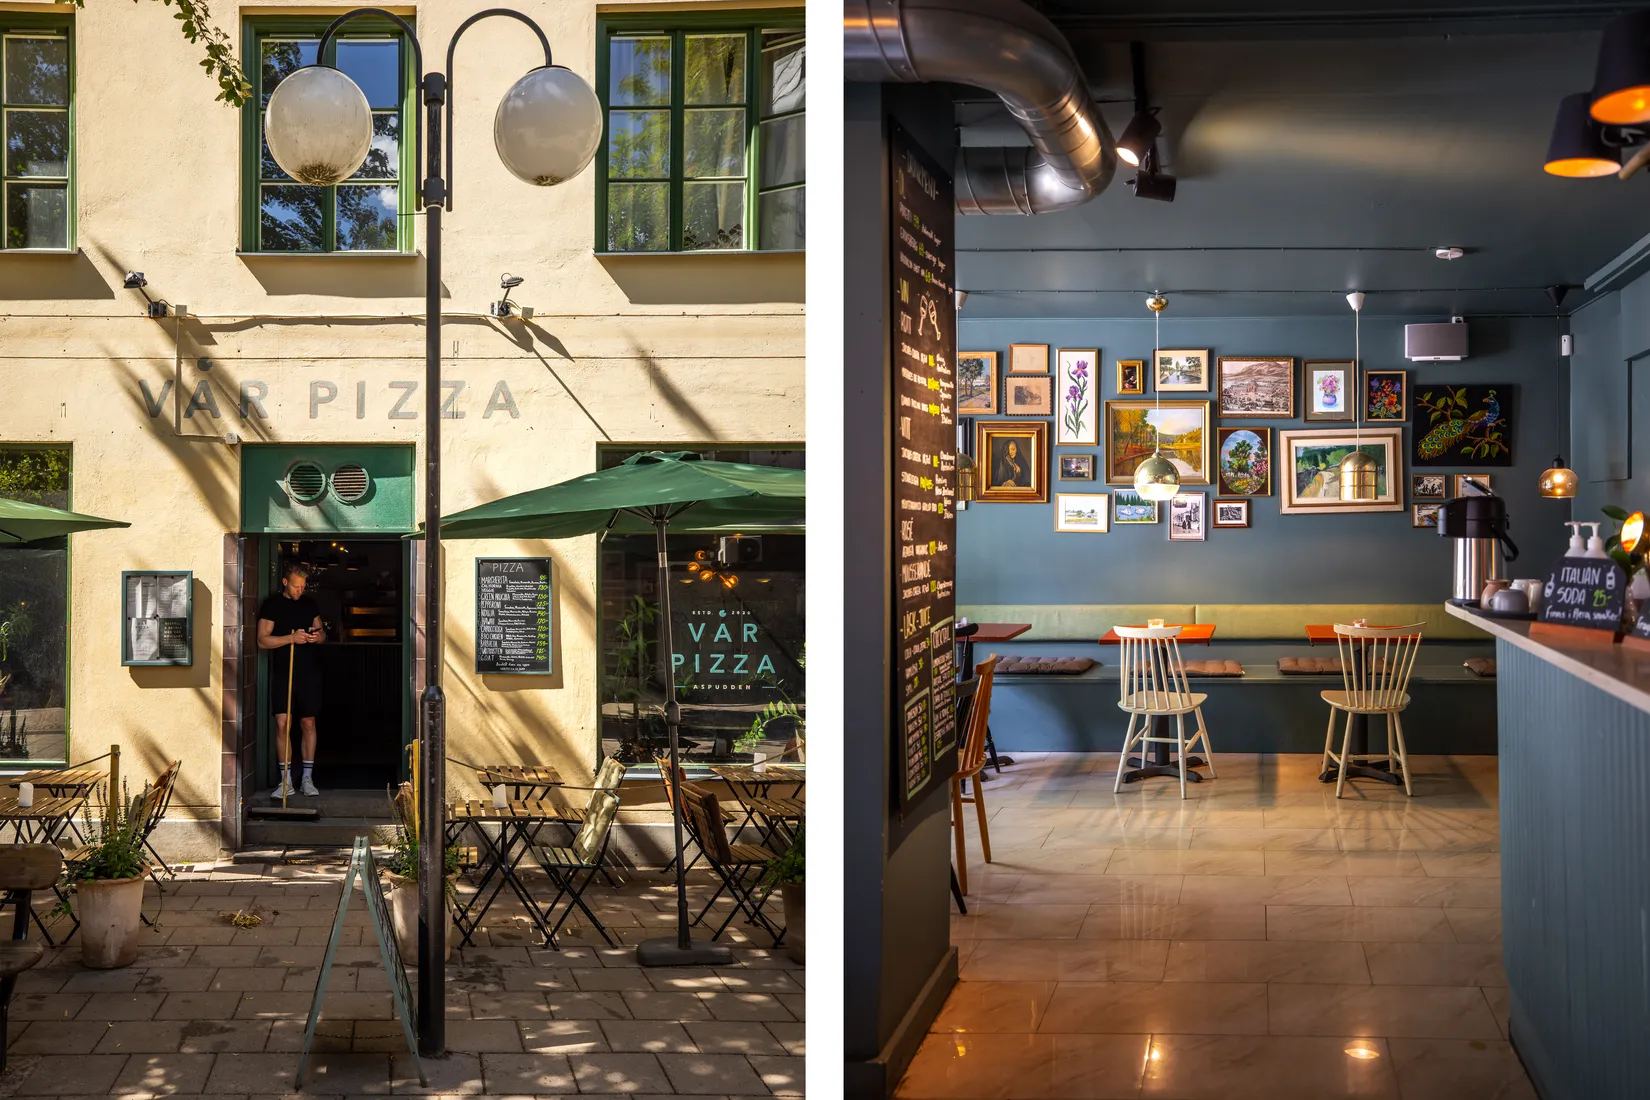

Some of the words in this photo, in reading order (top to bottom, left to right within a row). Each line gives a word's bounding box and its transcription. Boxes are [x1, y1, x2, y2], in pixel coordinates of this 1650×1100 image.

[309, 380, 521, 420] PIZZA
[492, 563, 524, 573] PIZZA
[1561, 567, 1601, 585] ITALIAN
[1557, 586, 1586, 605] SODA
[671, 653, 776, 674] PIZZA
